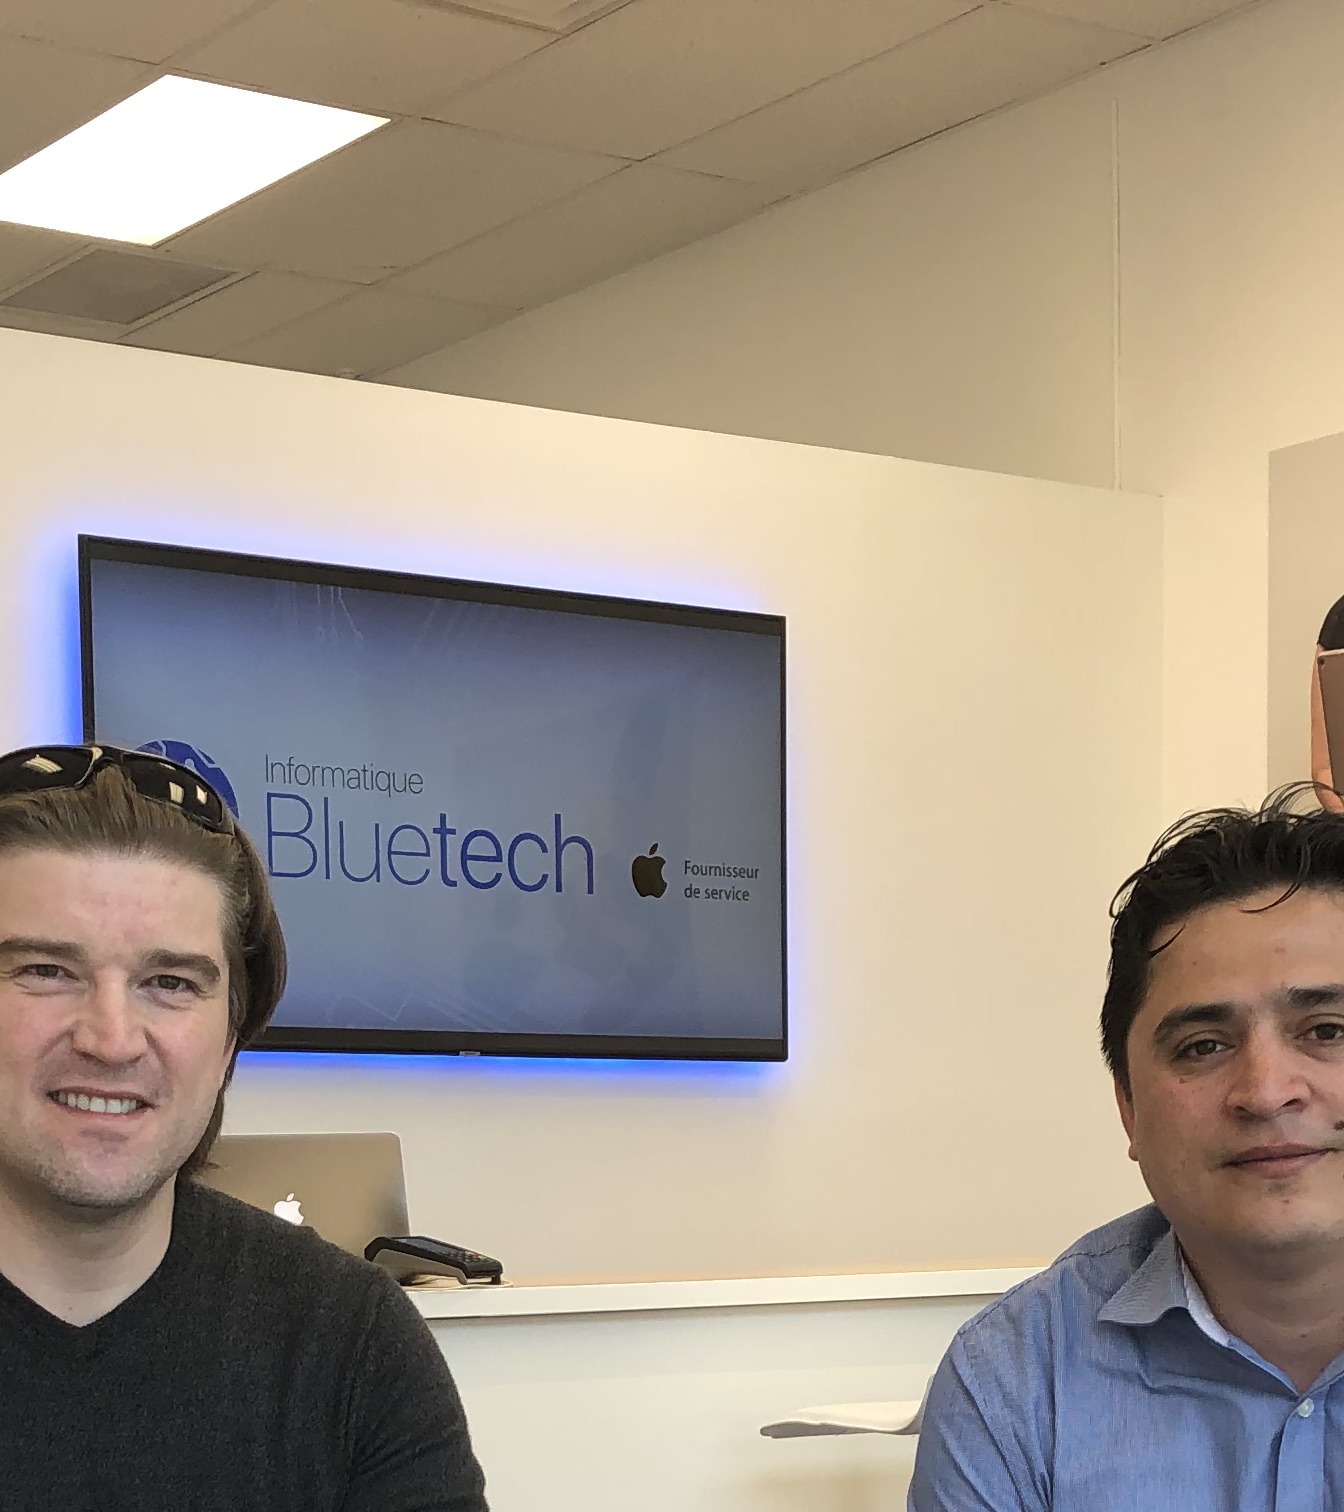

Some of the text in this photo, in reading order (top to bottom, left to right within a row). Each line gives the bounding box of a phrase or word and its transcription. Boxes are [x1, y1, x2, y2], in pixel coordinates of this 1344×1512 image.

[265, 753, 424, 798] Informatique
[267, 792, 594, 895] Bluetech
[684, 860, 760, 879] Fournisseur
[684, 883, 750, 901] de service
